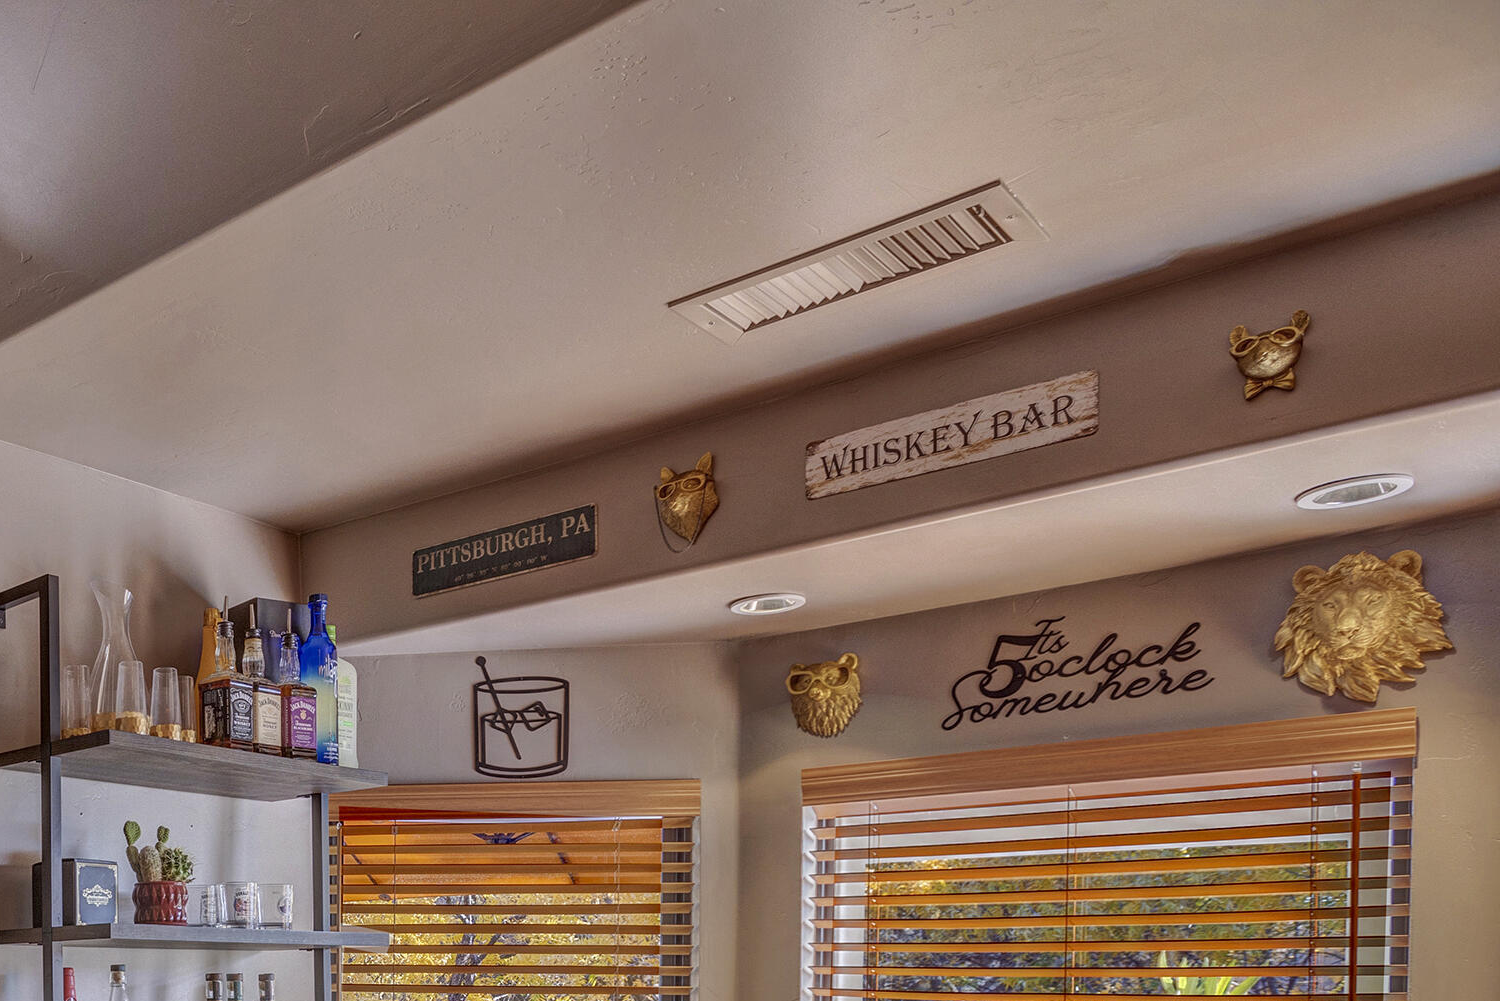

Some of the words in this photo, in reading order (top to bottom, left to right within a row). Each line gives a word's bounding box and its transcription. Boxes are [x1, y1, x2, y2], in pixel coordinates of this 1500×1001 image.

[820, 408, 983, 480] WHISKEY
[990, 395, 1075, 440] BAR
[416, 522, 554, 574] PITTSBURGH,
[560, 512, 591, 539] PA
[941, 664, 1216, 731] Somewhere
